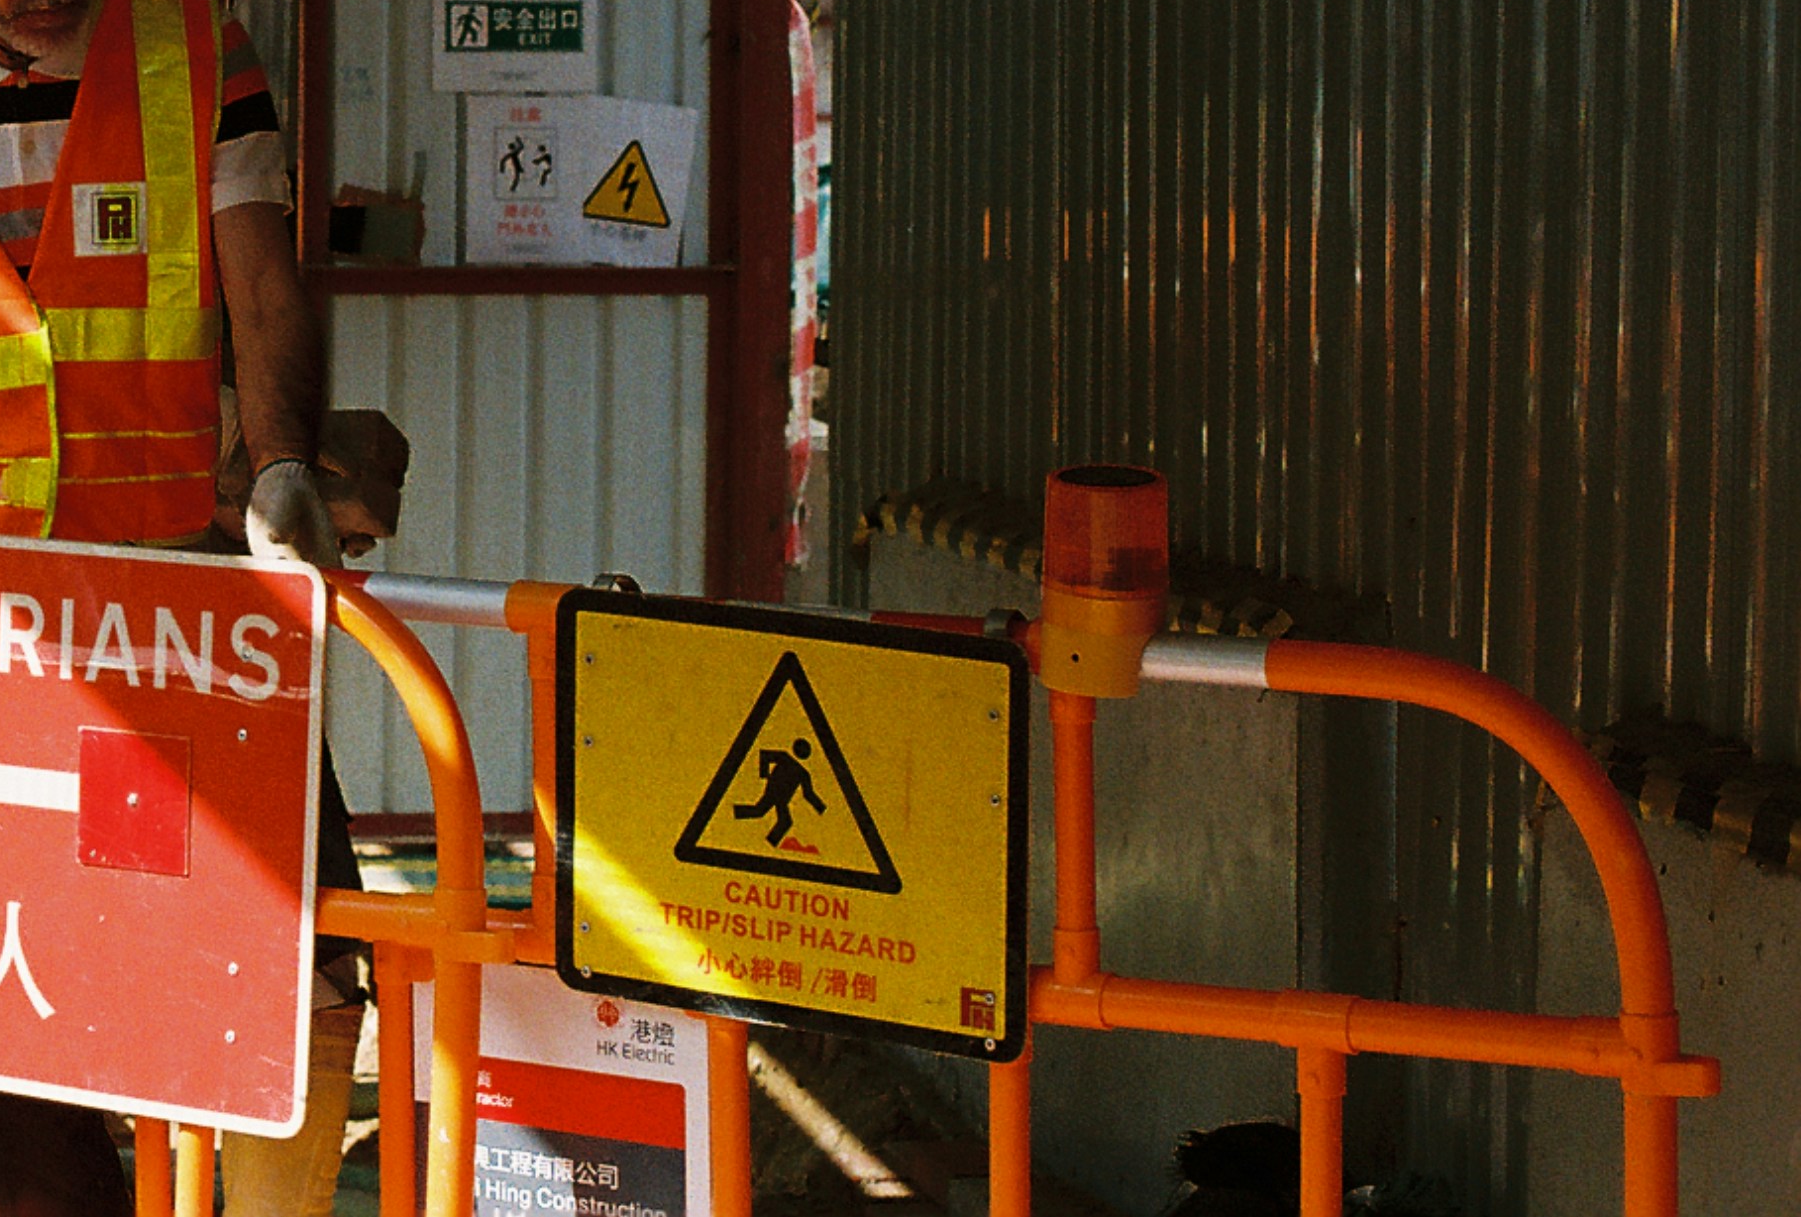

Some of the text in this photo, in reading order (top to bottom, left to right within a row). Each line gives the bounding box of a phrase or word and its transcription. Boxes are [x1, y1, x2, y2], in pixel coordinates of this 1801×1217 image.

[493, 7, 578, 31] 安全出口
[518, 31, 552, 46] EXIT
[724, 881, 851, 921] CAUTION
[659, 901, 917, 965] TRIP/SLIP HAZARD
[596, 1039, 676, 1066] HK Electric
[485, 1178, 532, 1209] Hing
[536, 1186, 667, 1217] Construction
